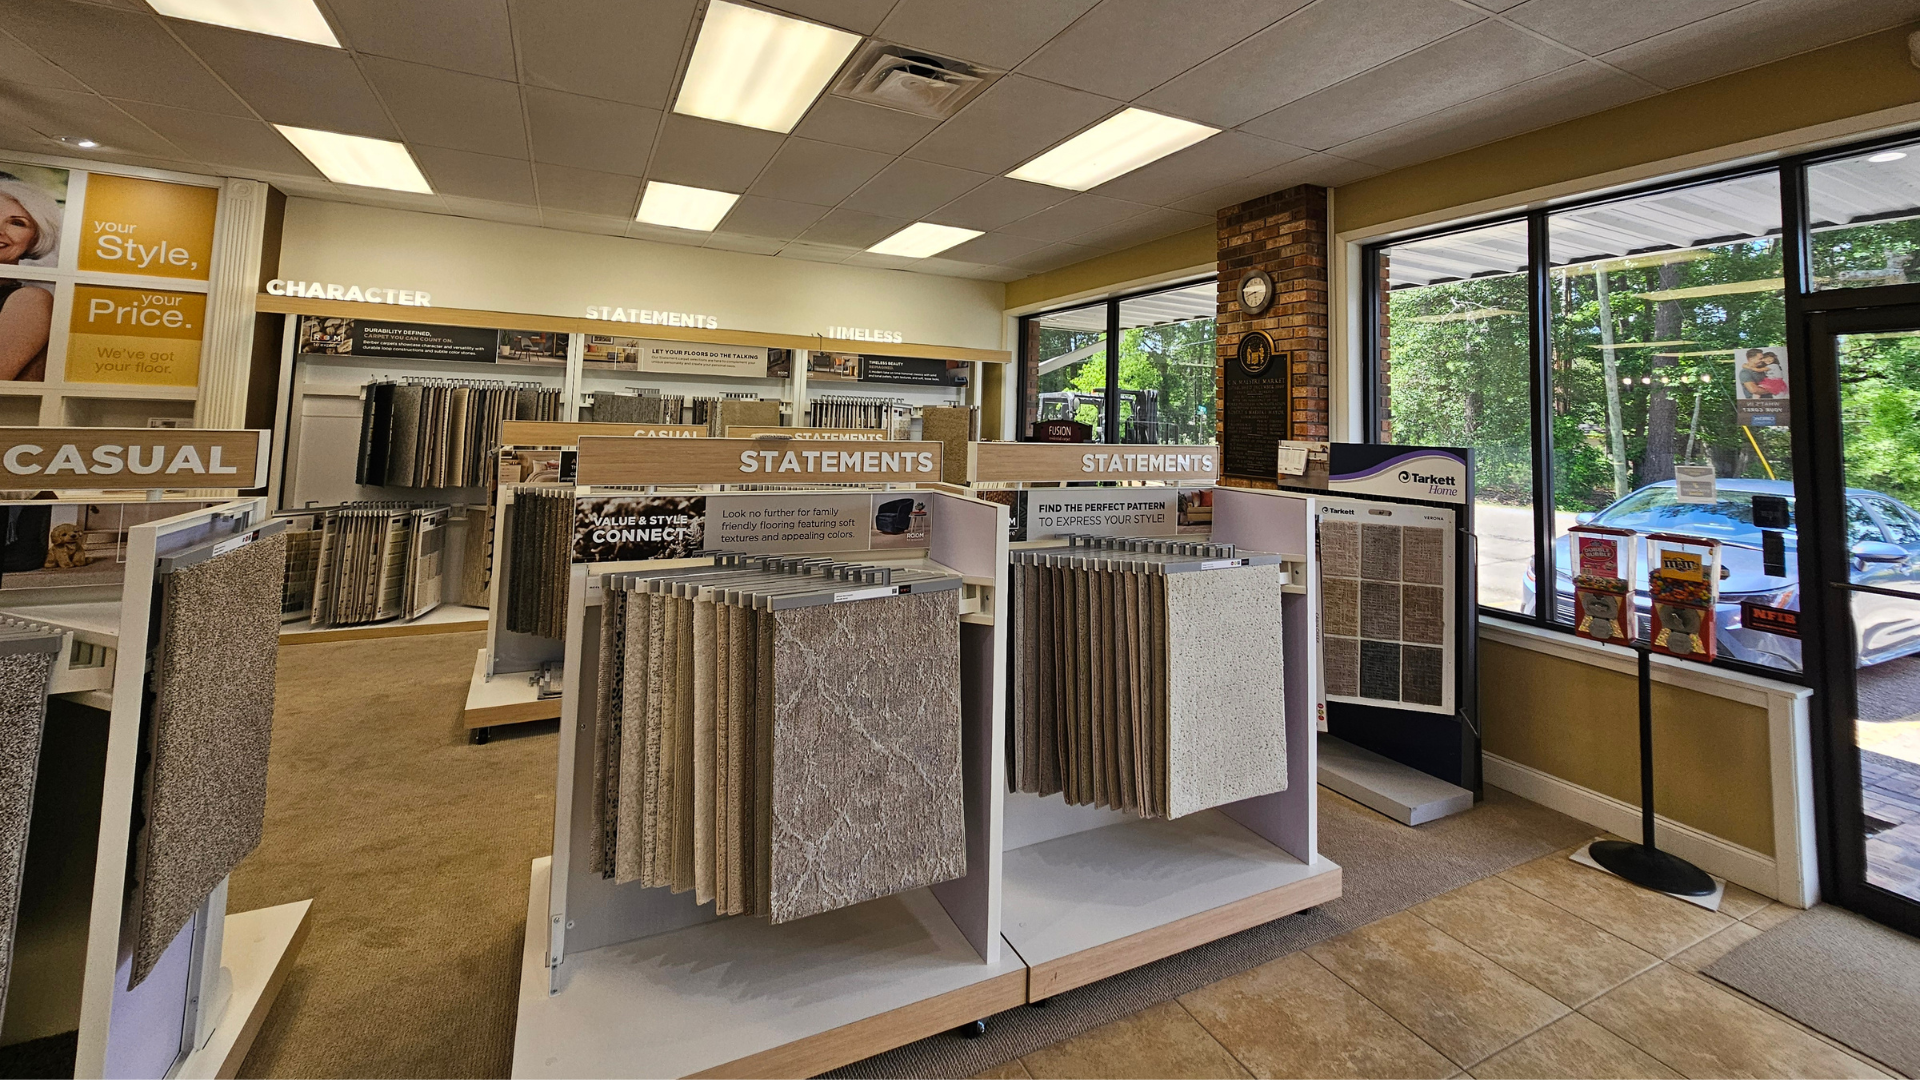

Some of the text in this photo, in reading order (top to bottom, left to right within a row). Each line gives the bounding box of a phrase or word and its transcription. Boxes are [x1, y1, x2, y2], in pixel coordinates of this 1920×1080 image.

[94, 220, 136, 234] your
[96, 235, 198, 270] Style,
[266, 279, 432, 307] CHARACTER
[142, 294, 182, 306] your
[88, 298, 192, 328] Price.
[586, 305, 718, 329] STATEMENTS
[404, 329, 432, 337] DEFINED,
[828, 326, 902, 343] TIMELESS
[98, 346, 174, 362] We've got
[94, 361, 172, 374] your floor.
[634, 430, 697, 438] CASUAL
[794, 432, 883, 440] STATEMENTS
[1048, 426, 1072, 436] FUSION
[2, 444, 237, 475] CASUAL
[740, 450, 933, 473] STATEMENTS
[1082, 454, 1213, 473] STATEMENTS
[1412, 473, 1456, 486] Tarkett
[1428, 485, 1458, 496] Home
[722, 510, 746, 518] Look
[764, 508, 794, 517] further
[798, 508, 810, 516] for
[813, 507, 839, 517] family
[1039, 502, 1166, 513] FIND THE PERFECT PATTERN
[594, 515, 688, 526] VALUE & STYLE
[722, 519, 855, 531] friendly flooring featuring soft
[1039, 514, 1165, 527] TO EXPRESS YOUR STYLE!
[592, 527, 687, 544] CONNECT
[721, 531, 855, 543] textures and appealing colors.
[1753, 608, 1796, 624] NFIB
